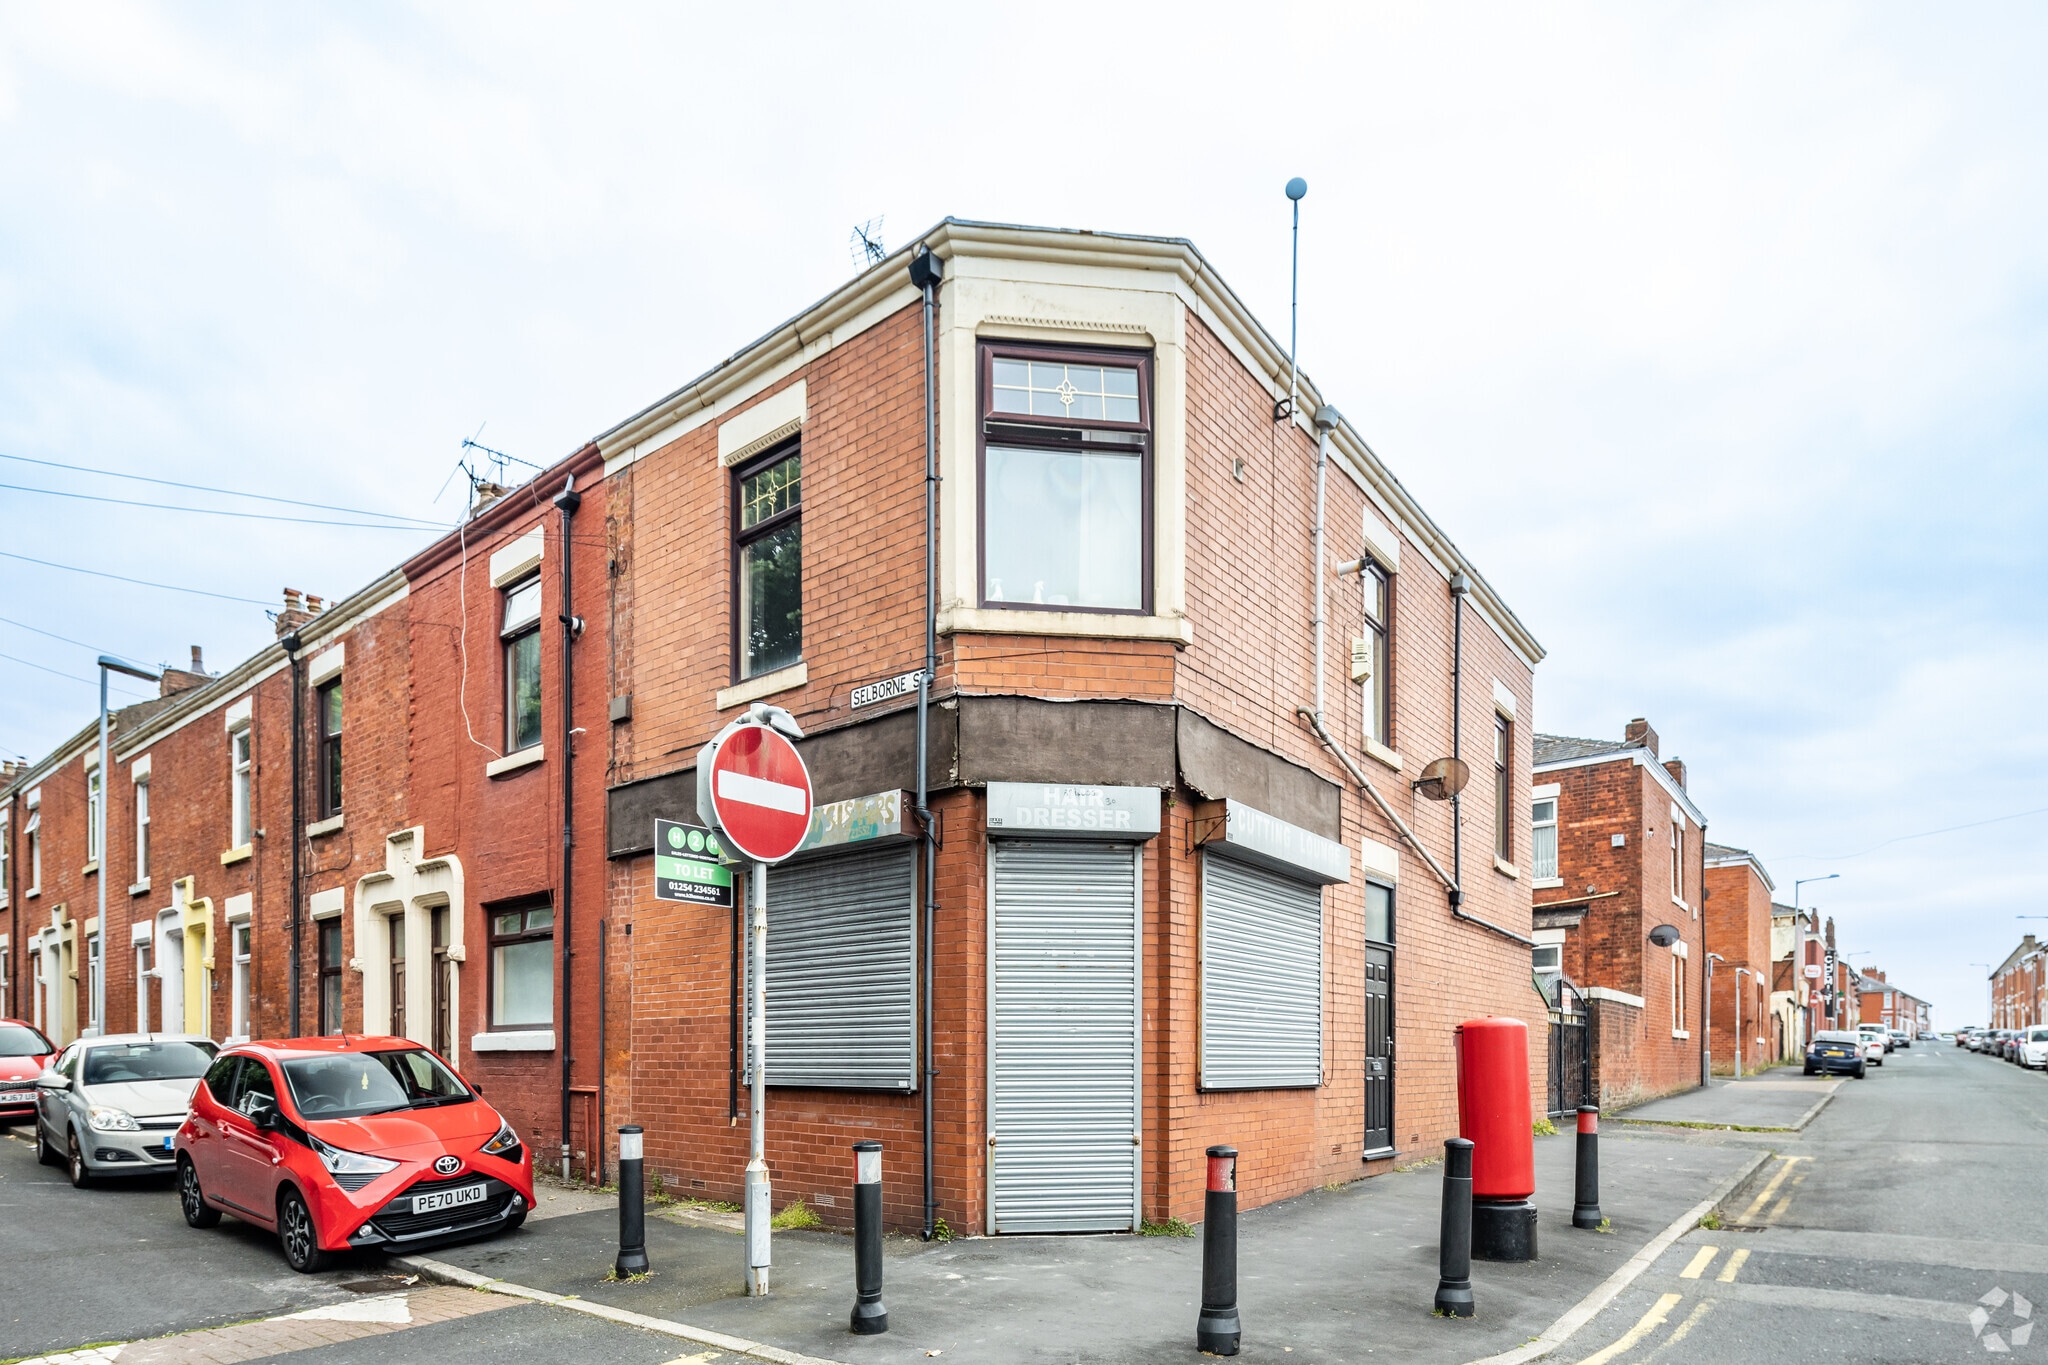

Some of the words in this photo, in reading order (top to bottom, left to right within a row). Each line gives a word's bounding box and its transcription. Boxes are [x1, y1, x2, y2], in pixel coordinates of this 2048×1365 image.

[853, 677, 906, 705] SELBORNE
[1043, 786, 1105, 807] HAIR
[1016, 807, 1131, 829] DRESSER
[1238, 808, 1291, 848] CUTTING
[1300, 832, 1341, 865] LOUNGE
[674, 863, 690, 877] TO
[693, 866, 714, 880] LET
[668, 881, 693, 892] 01254
[694, 885, 721, 896] 234561
[418, 1192, 453, 1211] PE70
[456, 1187, 481, 1203] UKD
